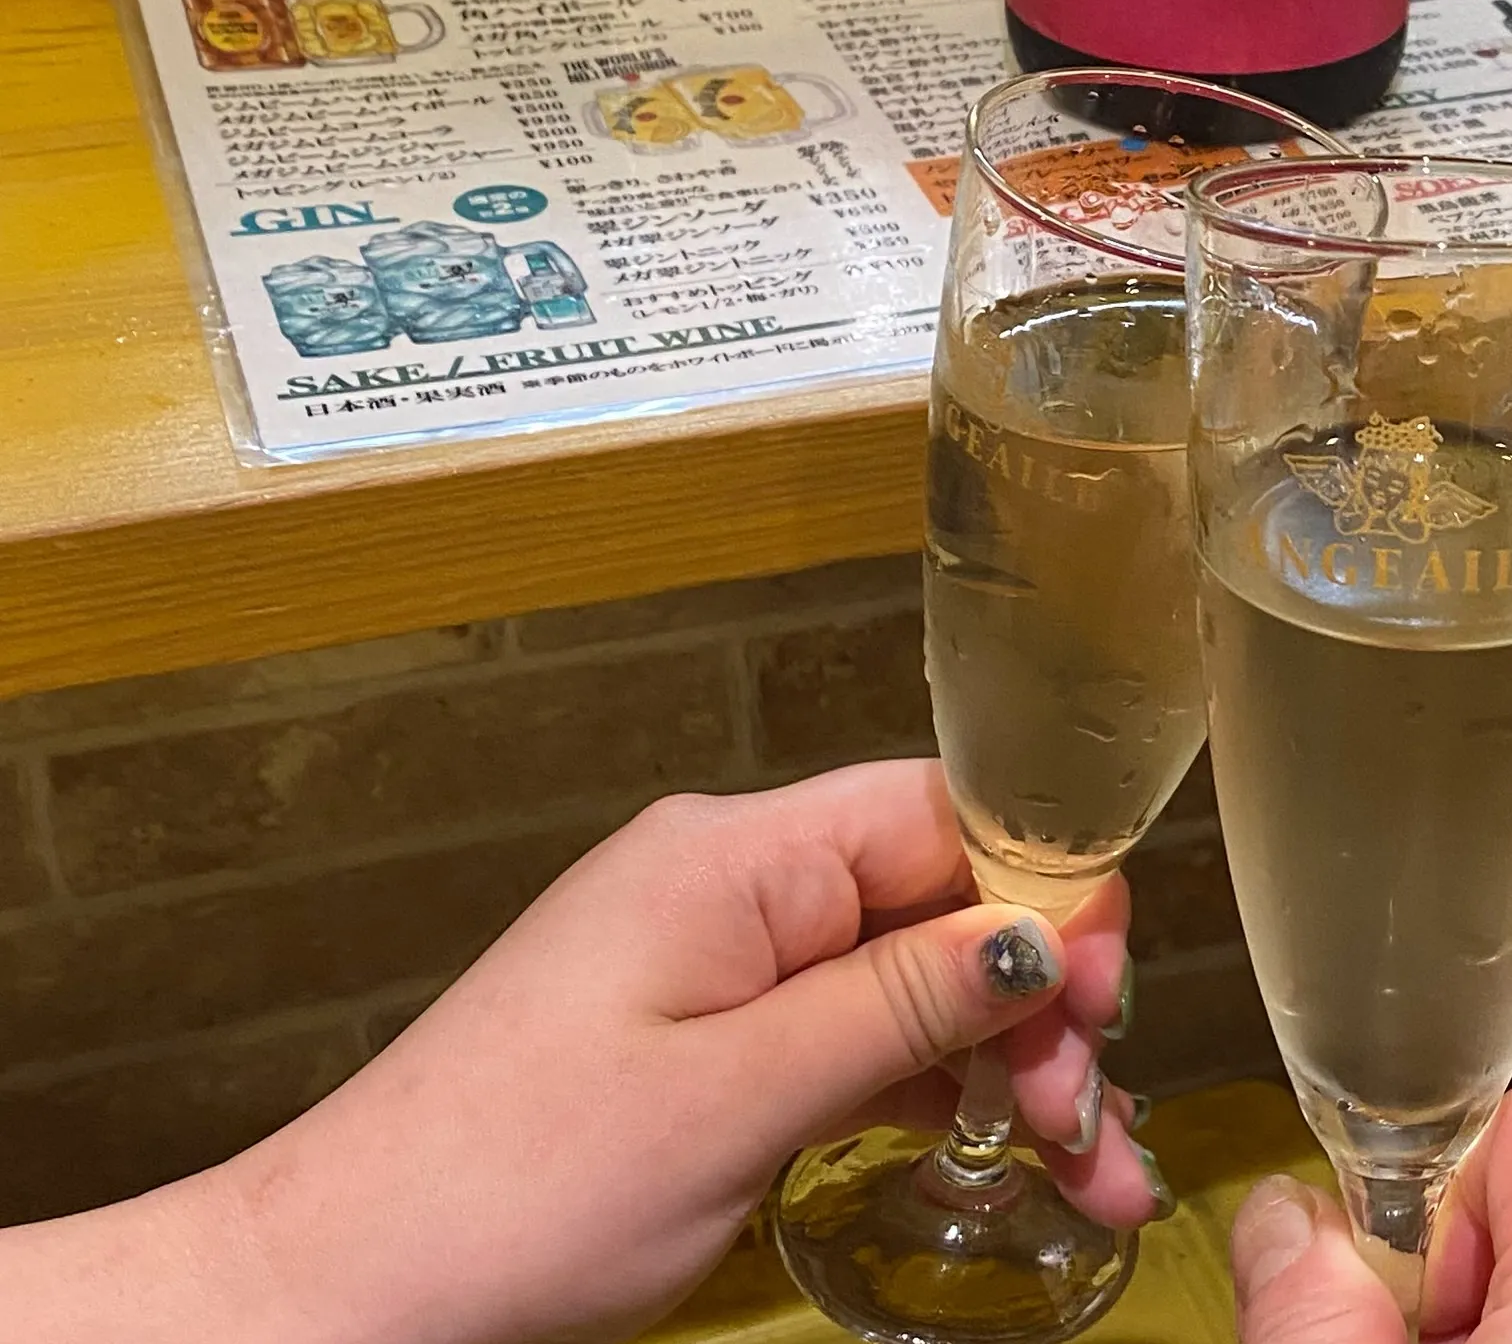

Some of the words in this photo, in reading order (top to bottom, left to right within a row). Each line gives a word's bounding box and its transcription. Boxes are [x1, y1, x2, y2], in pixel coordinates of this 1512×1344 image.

[239, 200, 384, 235] GIN
[584, 201, 775, 235] 翠ジンソーダ
[594, 217, 785, 249] メガ翠ジンソーダ
[601, 240, 765, 269] 翠ジントニック
[610, 247, 818, 284] メガ翠ジントニック
[285, 362, 433, 396] SAKE
[437, 356, 472, 377] /
[479, 336, 642, 370] FRUIT
[647, 315, 787, 348] WINE
[303, 382, 509, 415] 日本酒・果実酒
